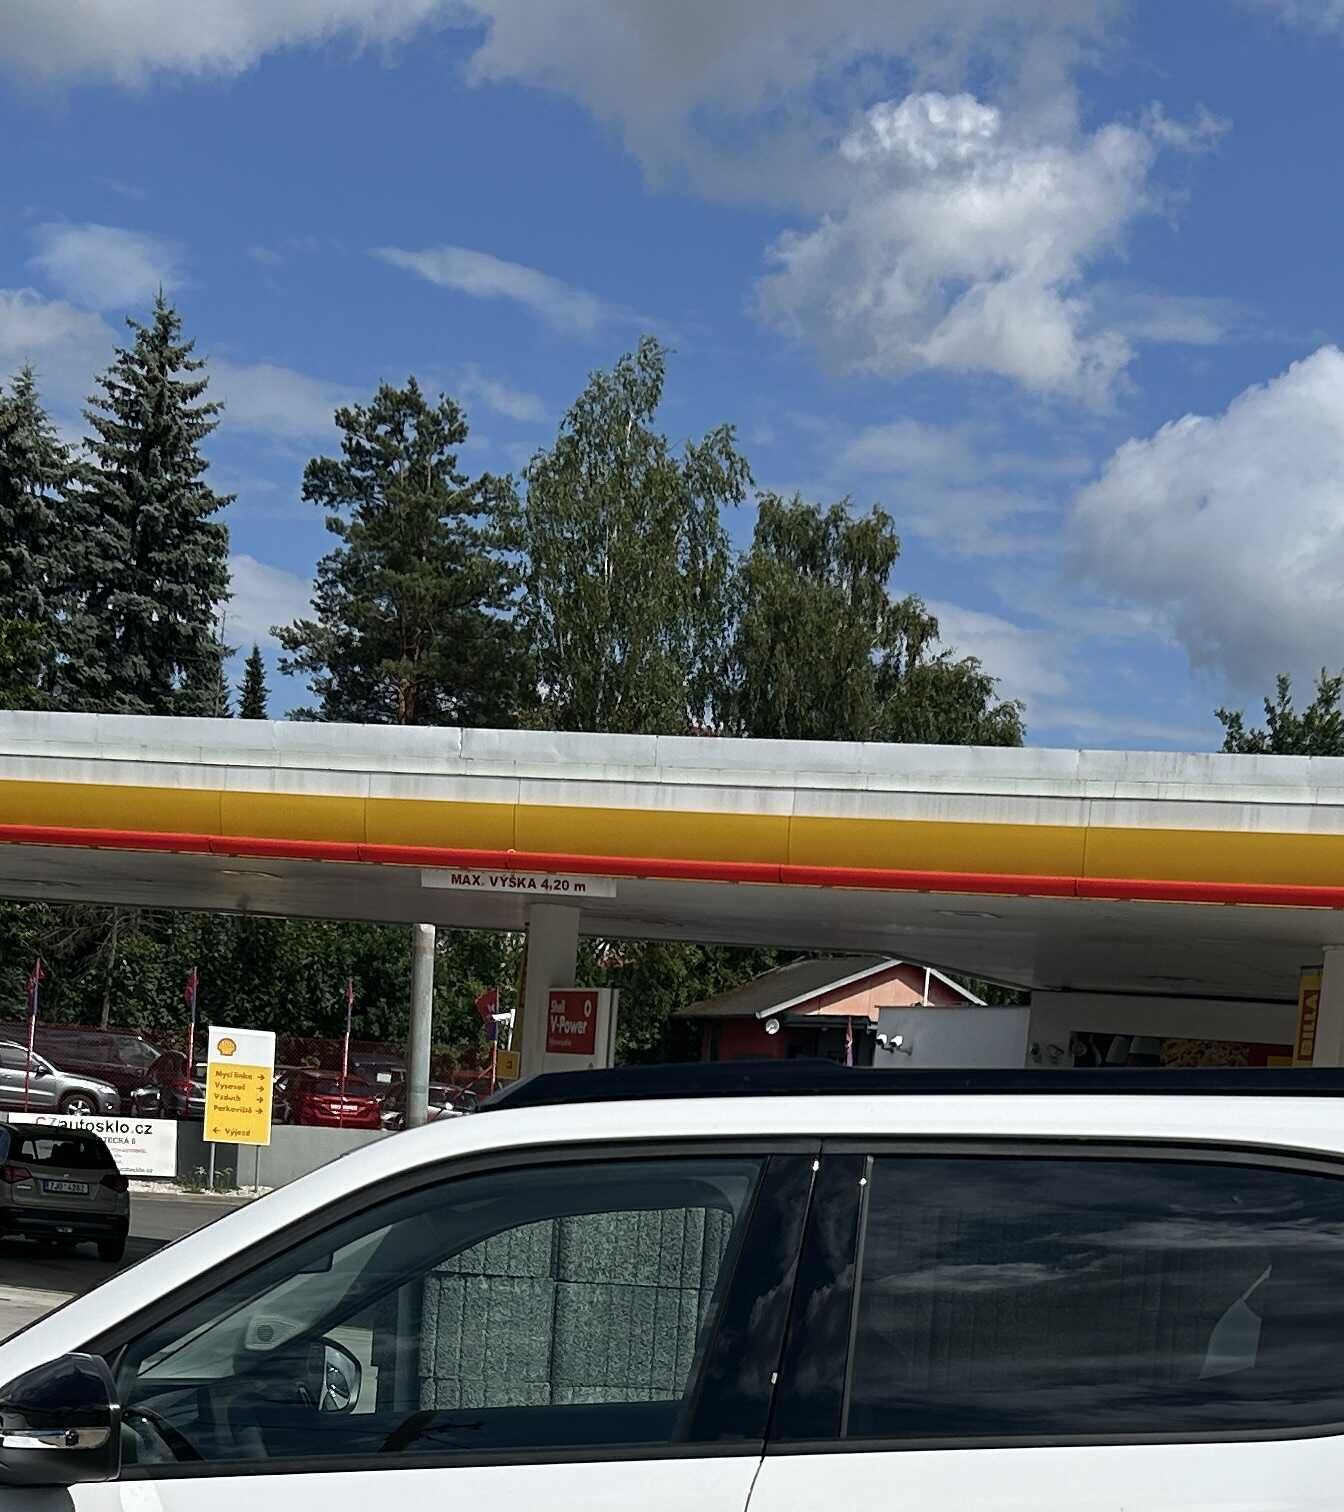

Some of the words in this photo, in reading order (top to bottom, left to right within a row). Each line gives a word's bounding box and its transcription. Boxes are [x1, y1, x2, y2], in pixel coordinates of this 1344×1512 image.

[451, 873, 485, 887] MAX.
[489, 872, 537, 890] VÝŠKA
[541, 879, 570, 892] 4,20
[574, 883, 586, 892] m
[550, 1015, 588, 1035] V-Power
